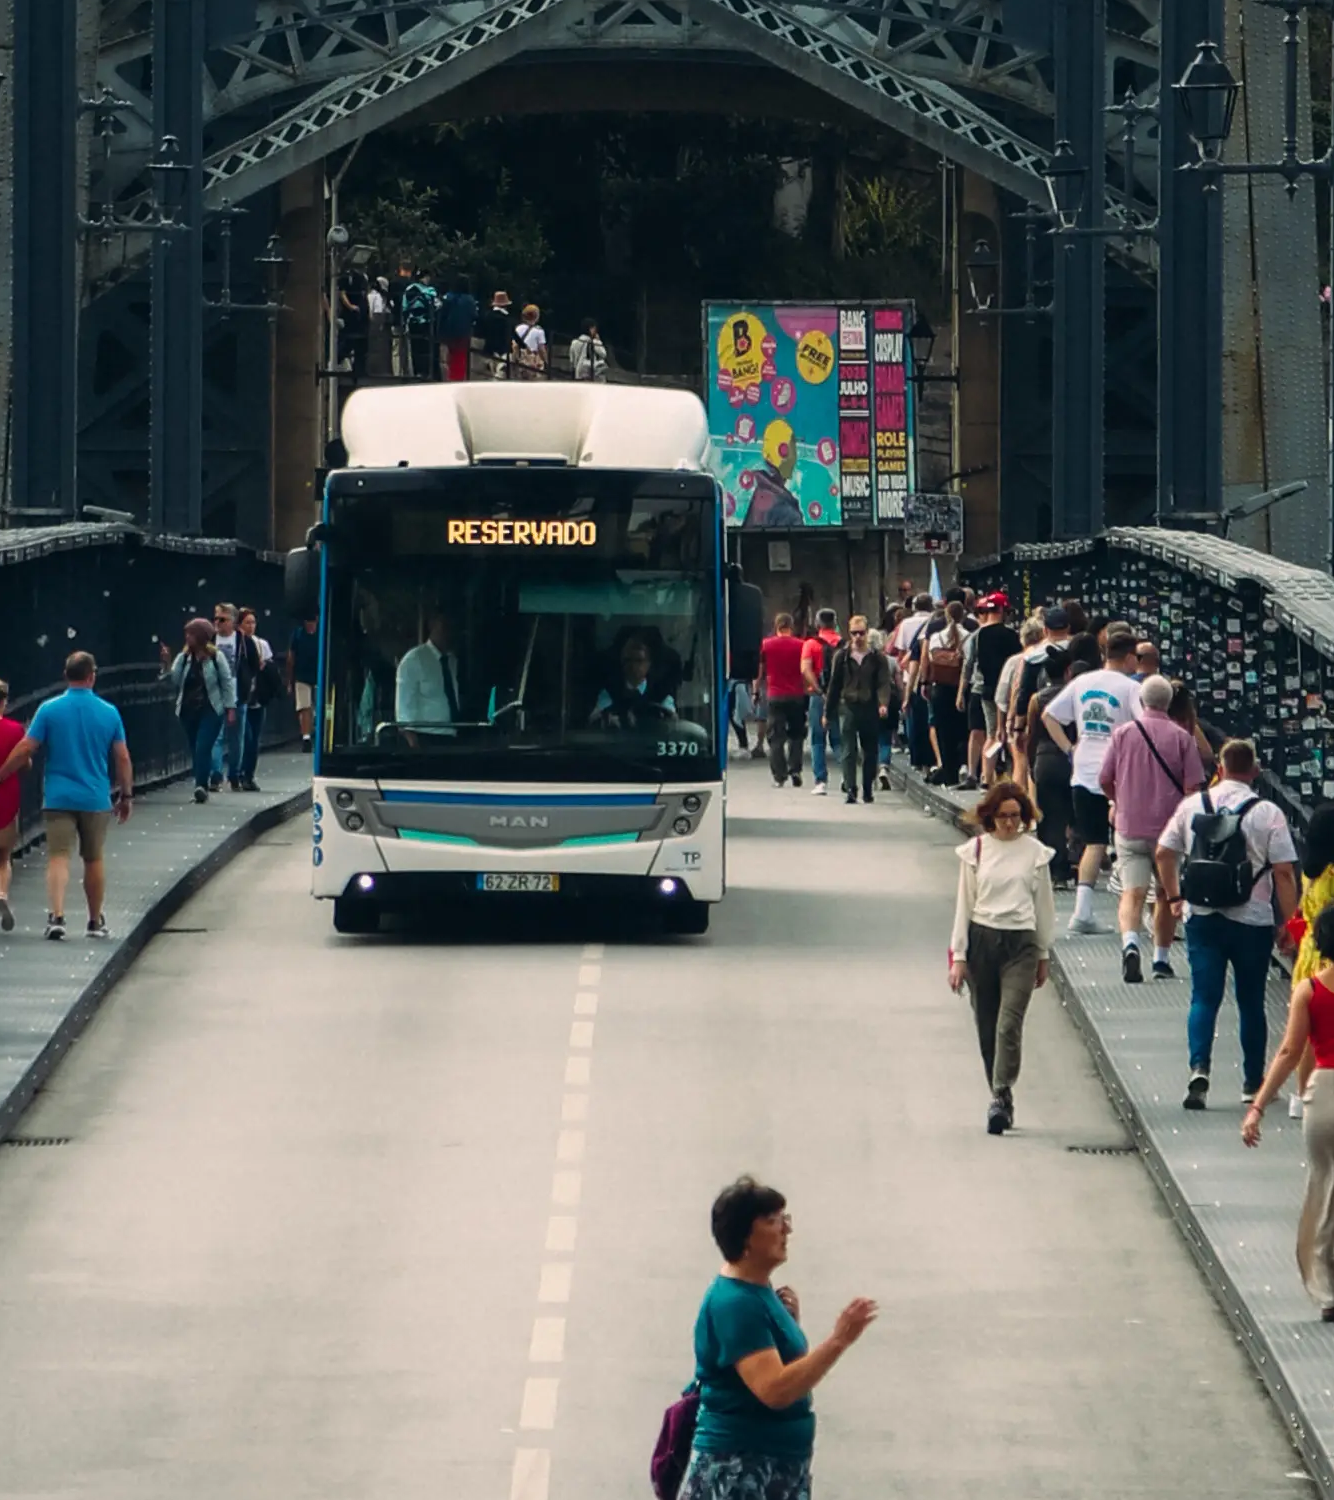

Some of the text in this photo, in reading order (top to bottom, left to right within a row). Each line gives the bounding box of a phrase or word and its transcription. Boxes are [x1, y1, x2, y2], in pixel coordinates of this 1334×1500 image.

[840, 310, 866, 328] BANG
[802, 344, 831, 367] FREE
[874, 333, 904, 363] COSPLAY
[839, 381, 868, 396] JULHO
[876, 431, 906, 447] ROLE
[877, 448, 906, 459] PLAYING
[877, 460, 907, 472] GAMES
[841, 475, 870, 497] MUSIC
[878, 491, 906, 518] MORE
[448, 520, 597, 545] RESERVADO
[657, 741, 698, 756] 3370
[489, 816, 549, 828] MAN
[682, 852, 701, 865] TP
[486, 875, 551, 889] 62 ZR 72
